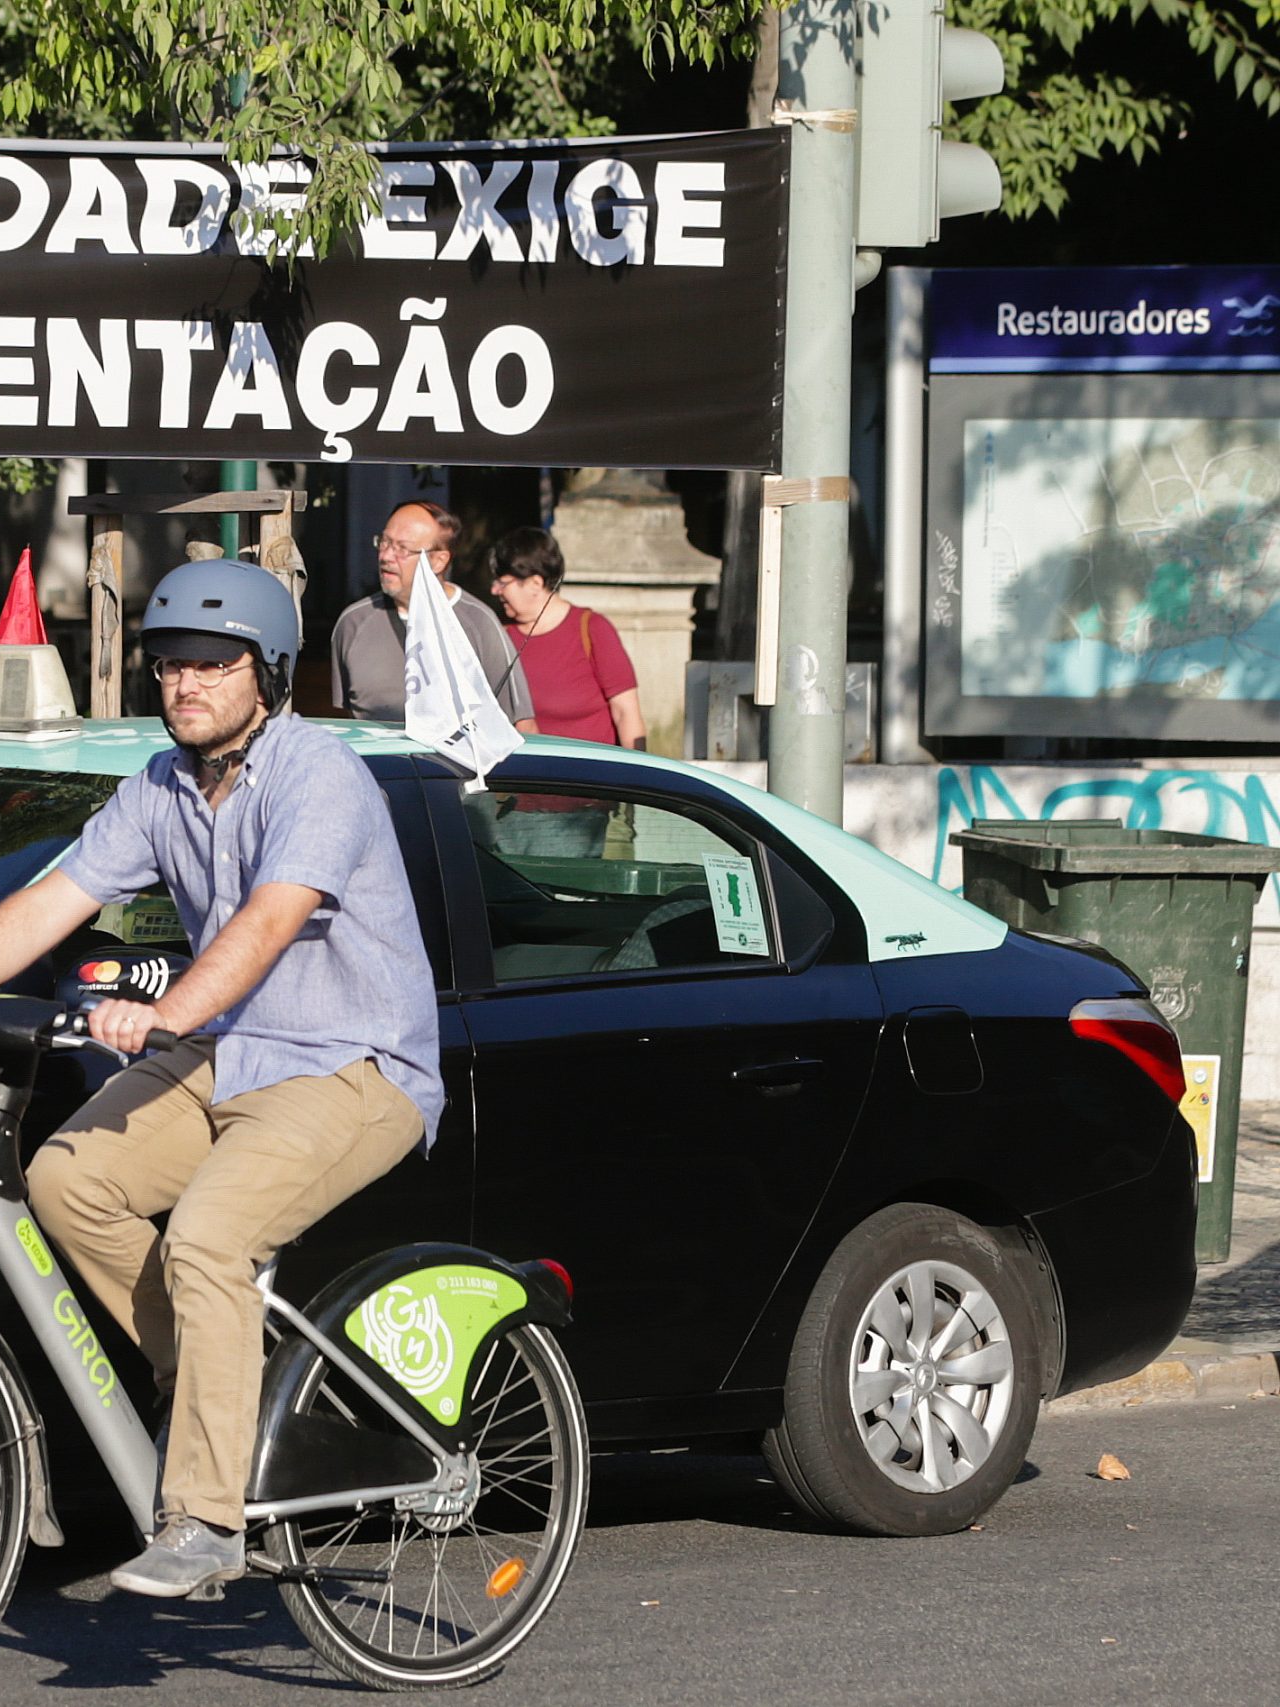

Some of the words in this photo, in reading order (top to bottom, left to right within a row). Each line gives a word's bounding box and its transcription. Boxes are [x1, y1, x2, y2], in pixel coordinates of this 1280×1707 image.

[357, 158, 726, 268] EXIGE
[997, 299, 1211, 336] Restauradores
[78, 983, 119, 991] mastercard
